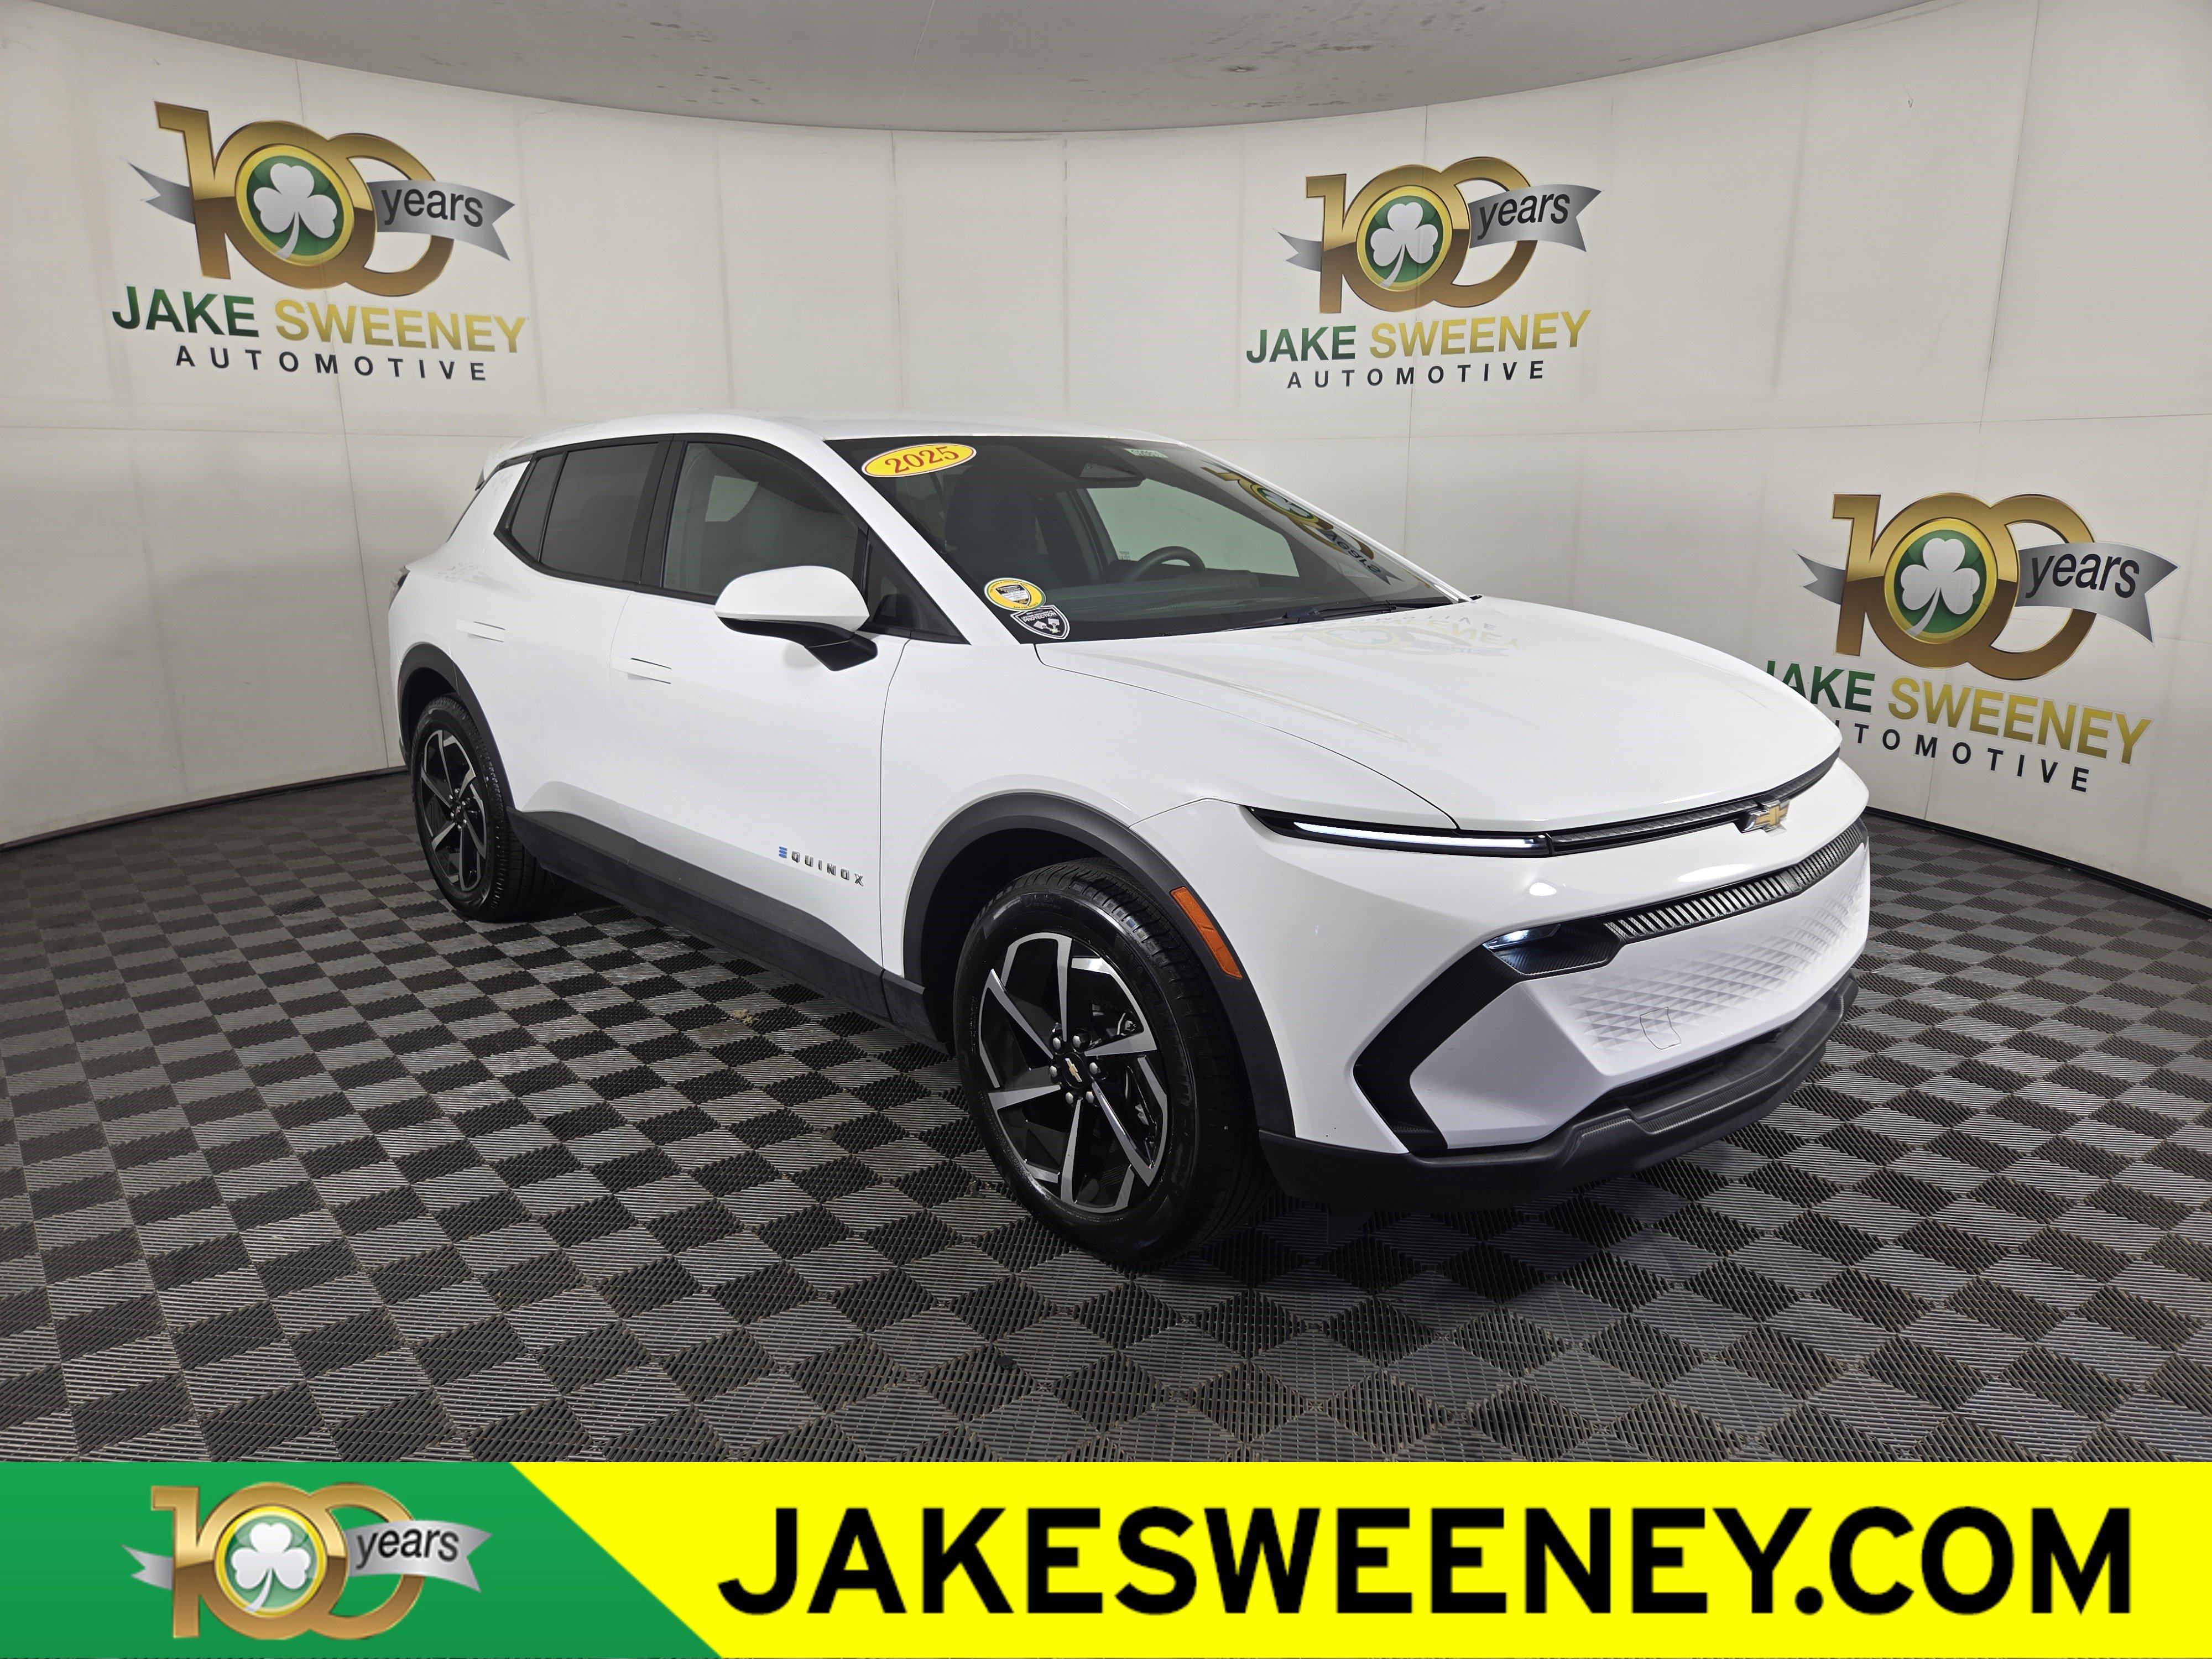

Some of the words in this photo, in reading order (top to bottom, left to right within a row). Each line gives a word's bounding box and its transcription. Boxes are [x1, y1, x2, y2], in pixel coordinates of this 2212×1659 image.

[380, 186, 484, 228] years
[1477, 192, 1570, 240] years
[112, 285, 260, 338] JAKE
[275, 299, 526, 353] SWEENEY
[1246, 325, 1356, 363] JAKE
[1370, 309, 1592, 358] SWEENEY
[176, 346, 486, 381] AUTOMOTIVE
[1287, 360, 1543, 388] AUTOMOTIVE
[885, 446, 959, 474] 2025
[2025, 552, 2140, 598] years
[1888, 677, 2152, 765] SWEENEY
[1835, 720, 2089, 793] TOMOTIVE
[779, 846, 863, 886] EQUINOX
